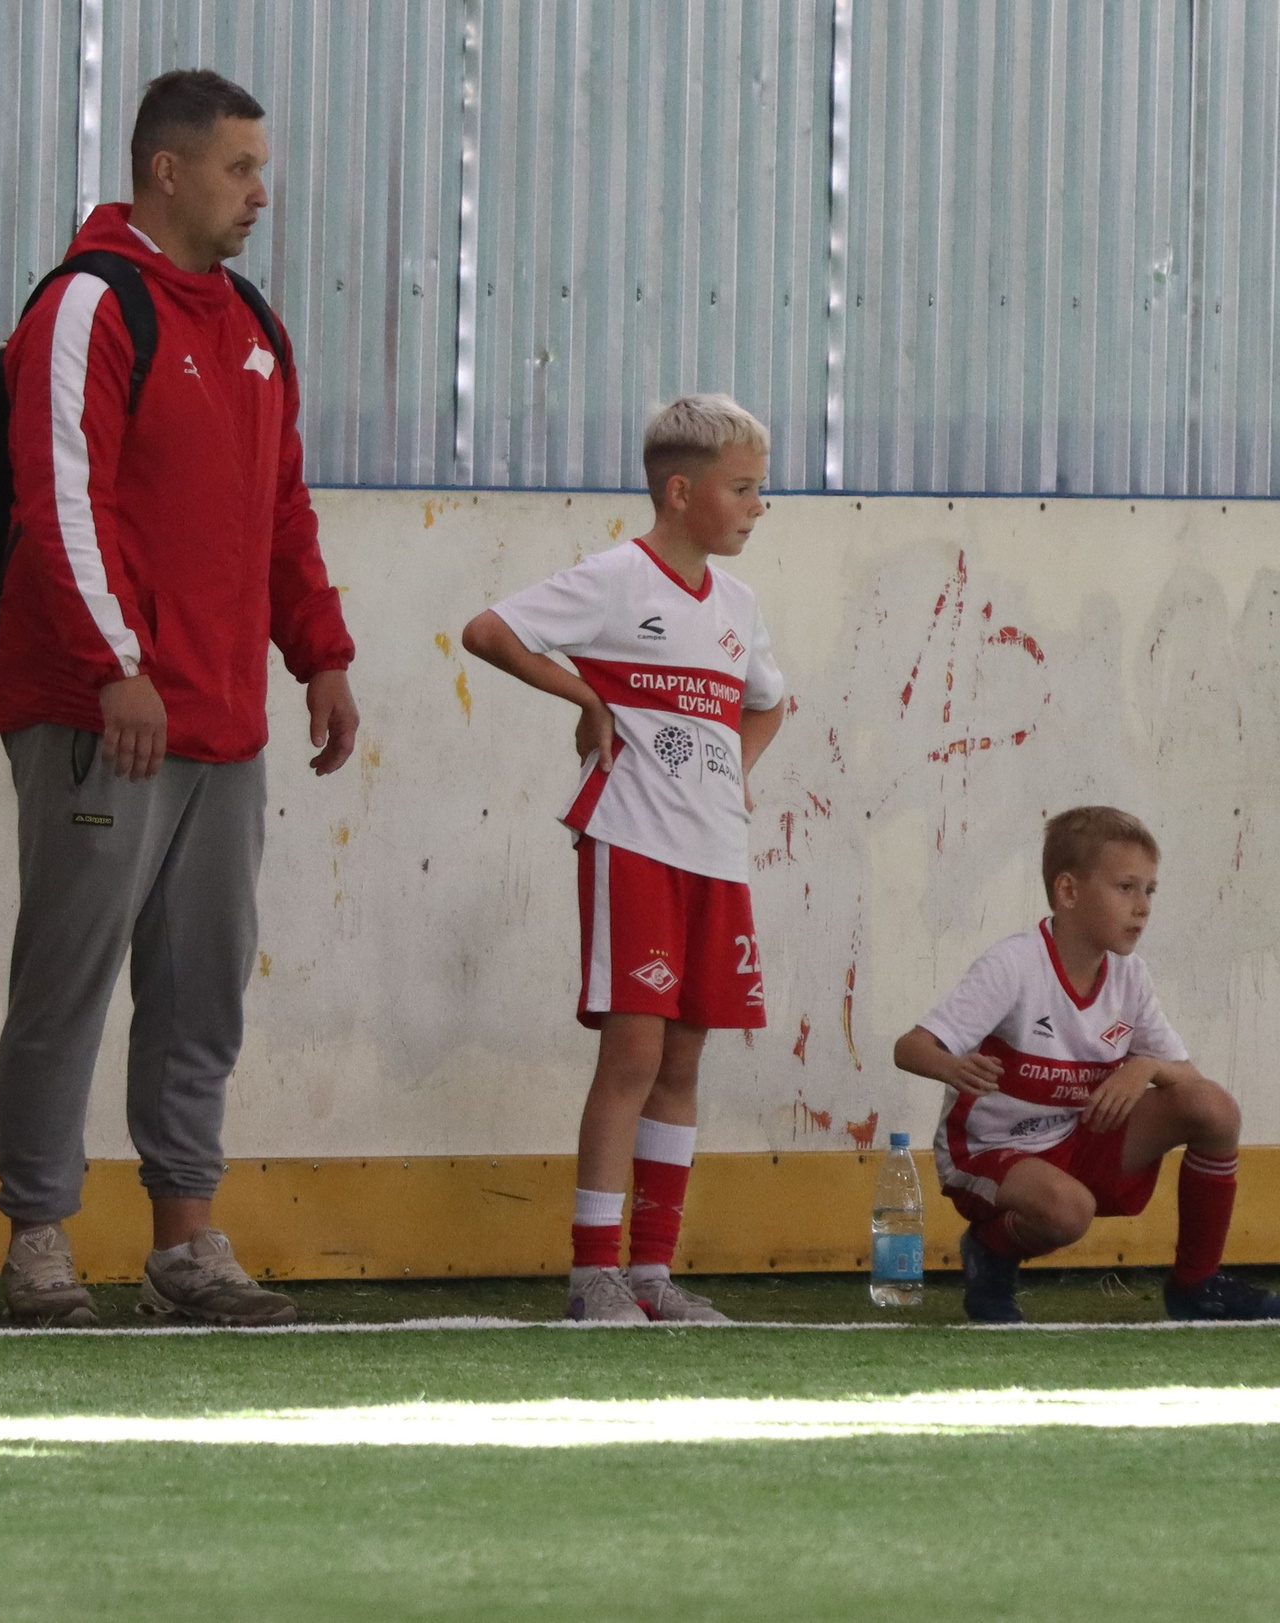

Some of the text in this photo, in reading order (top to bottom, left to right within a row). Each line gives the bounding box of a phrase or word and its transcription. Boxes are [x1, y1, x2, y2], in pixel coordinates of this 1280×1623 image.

[630, 673, 740, 704] СПАРТАК ЮНИОР
[678, 694, 722, 716] ДУБНА
[1051, 1085, 1090, 1100] ДУБНА
